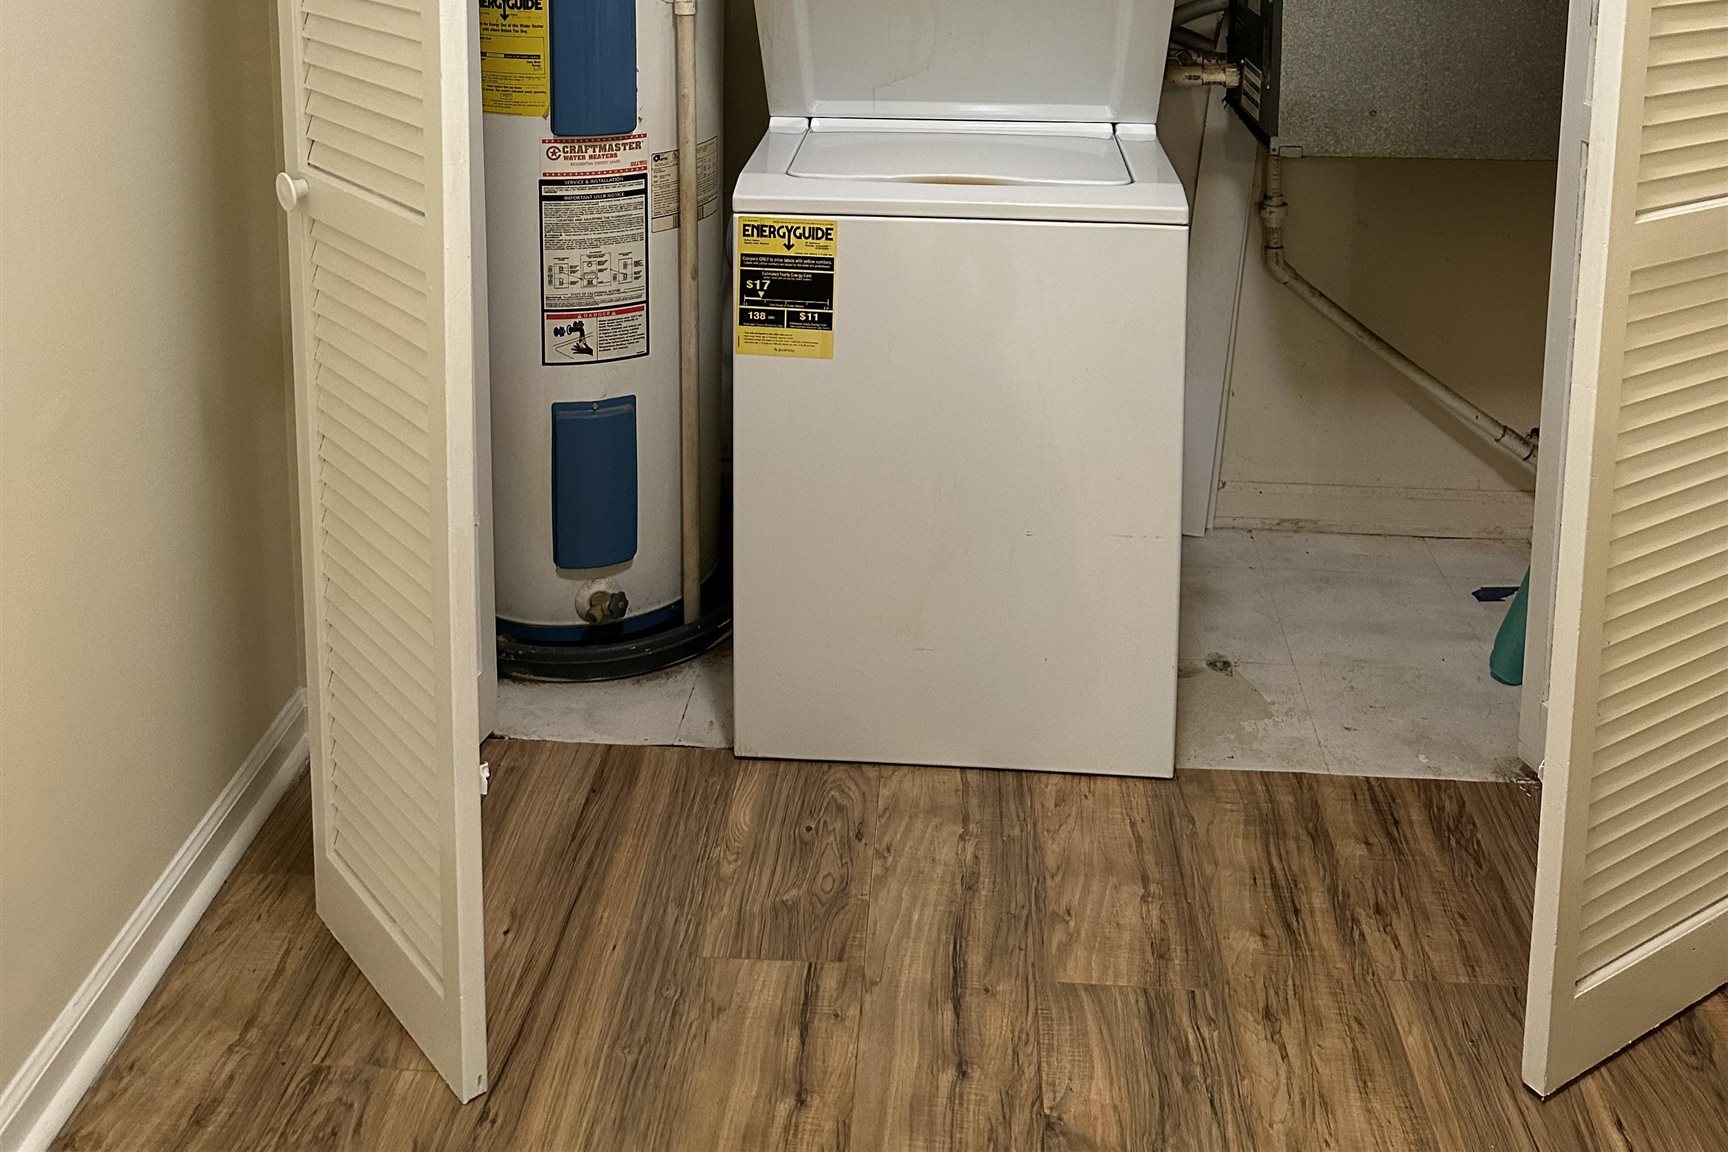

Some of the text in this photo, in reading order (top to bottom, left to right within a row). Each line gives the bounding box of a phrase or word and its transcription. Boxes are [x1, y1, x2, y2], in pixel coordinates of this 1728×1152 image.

[562, 141, 642, 154] CRAFTMASTER
[743, 224, 833, 241] ENERGYGUIDE
[746, 280, 770, 290] $17
[748, 312, 766, 320] 138
[800, 312, 818, 321] $11
